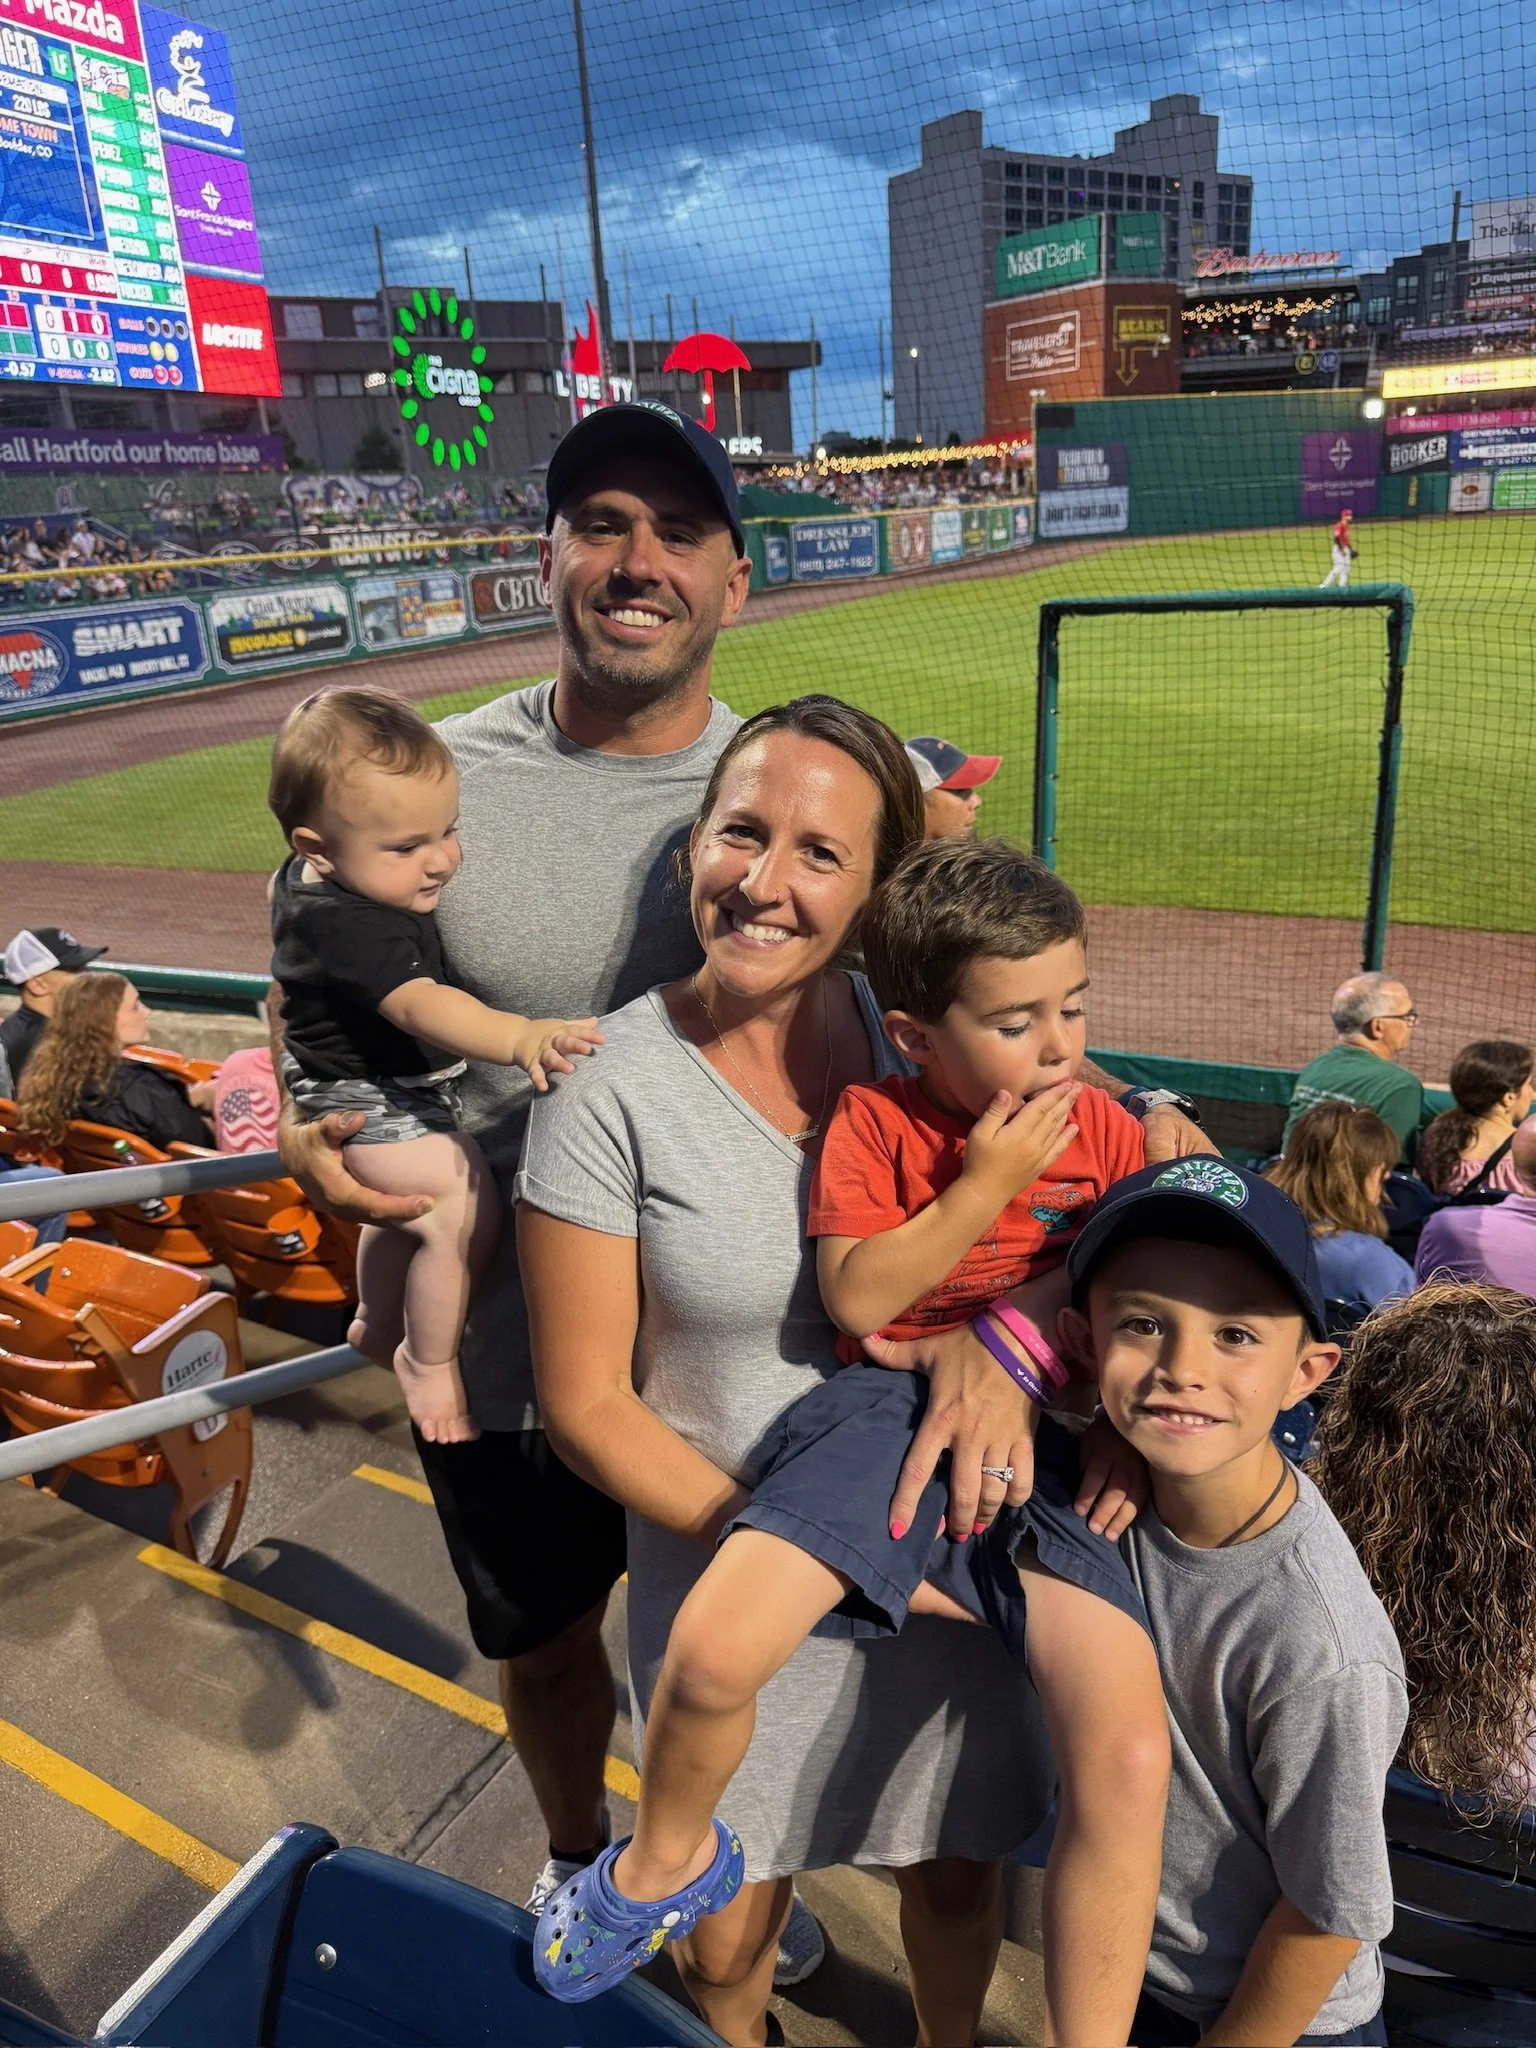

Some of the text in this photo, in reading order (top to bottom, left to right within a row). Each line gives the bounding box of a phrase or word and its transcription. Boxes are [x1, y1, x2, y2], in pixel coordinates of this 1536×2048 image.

[0, 27, 44, 76] GER
[1480, 224, 1508, 239] The
[1007, 238, 1087, 279] M&T Bank
[1192, 247, 1339, 278] Budweiser
[555, 369, 633, 403] LBETY
[33, 437, 124, 464] Hartford
[128, 443, 163, 464] our
[163, 439, 217, 464] home
[218, 441, 261, 464] base
[720, 436, 763, 456] ERS
[1391, 436, 1447, 468] HOOKER
[797, 524, 872, 542] DRESSLER
[816, 539, 852, 553] LAW
[72, 616, 184, 657] SMART
[1160, 1160, 1241, 1186] HARTFORD
